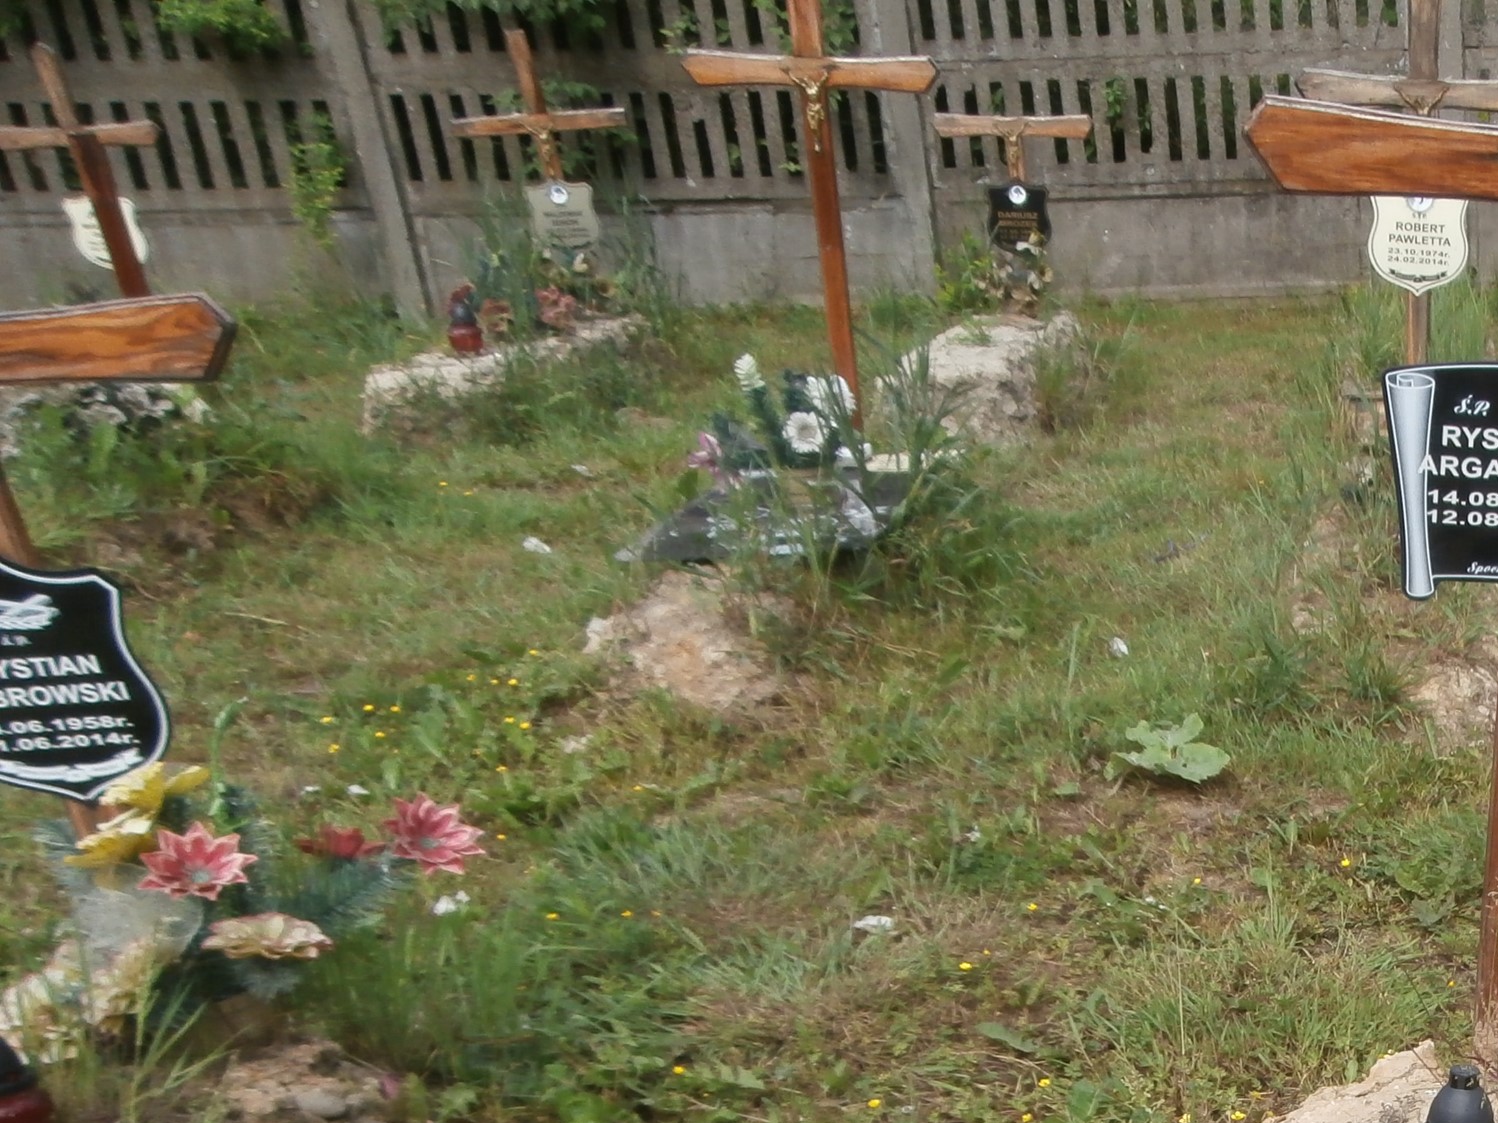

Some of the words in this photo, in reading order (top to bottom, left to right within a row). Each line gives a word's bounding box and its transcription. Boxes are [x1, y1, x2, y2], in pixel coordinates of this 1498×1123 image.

[1395, 221, 1445, 233] ROBERT
[1388, 234, 1451, 247] PAWLETTA
[1387, 247, 1450, 258] 23.10.1974r.
[1387, 255, 1449, 266] 24.02.2014r.
[0, 714, 135, 735] .06.1958r.
